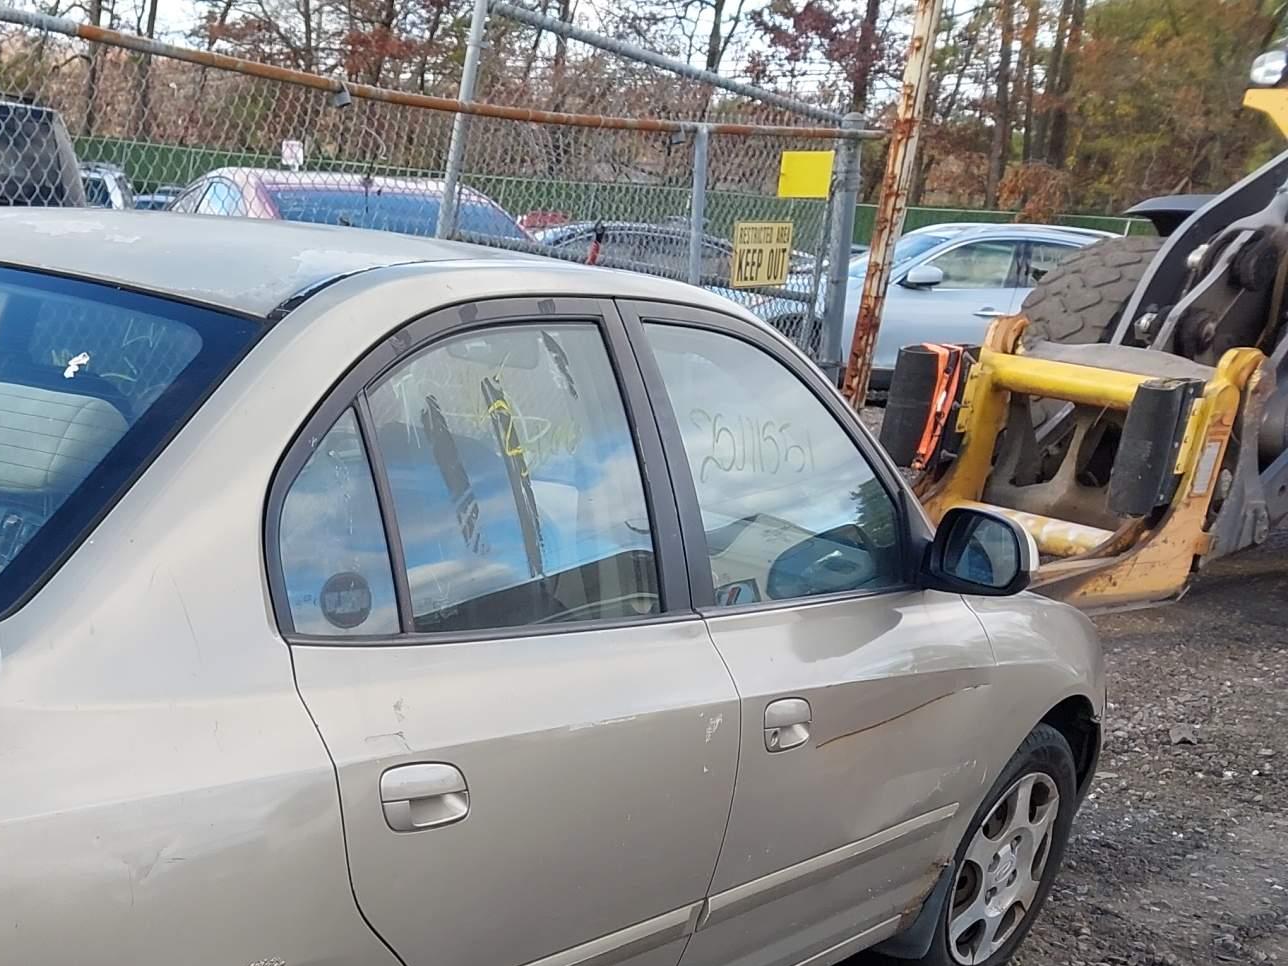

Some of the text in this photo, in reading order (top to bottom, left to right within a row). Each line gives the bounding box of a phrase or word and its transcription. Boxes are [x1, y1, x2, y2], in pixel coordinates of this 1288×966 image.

[739, 226, 791, 244] RESTRICTED AREA
[736, 247, 788, 282] KEEP OUT
